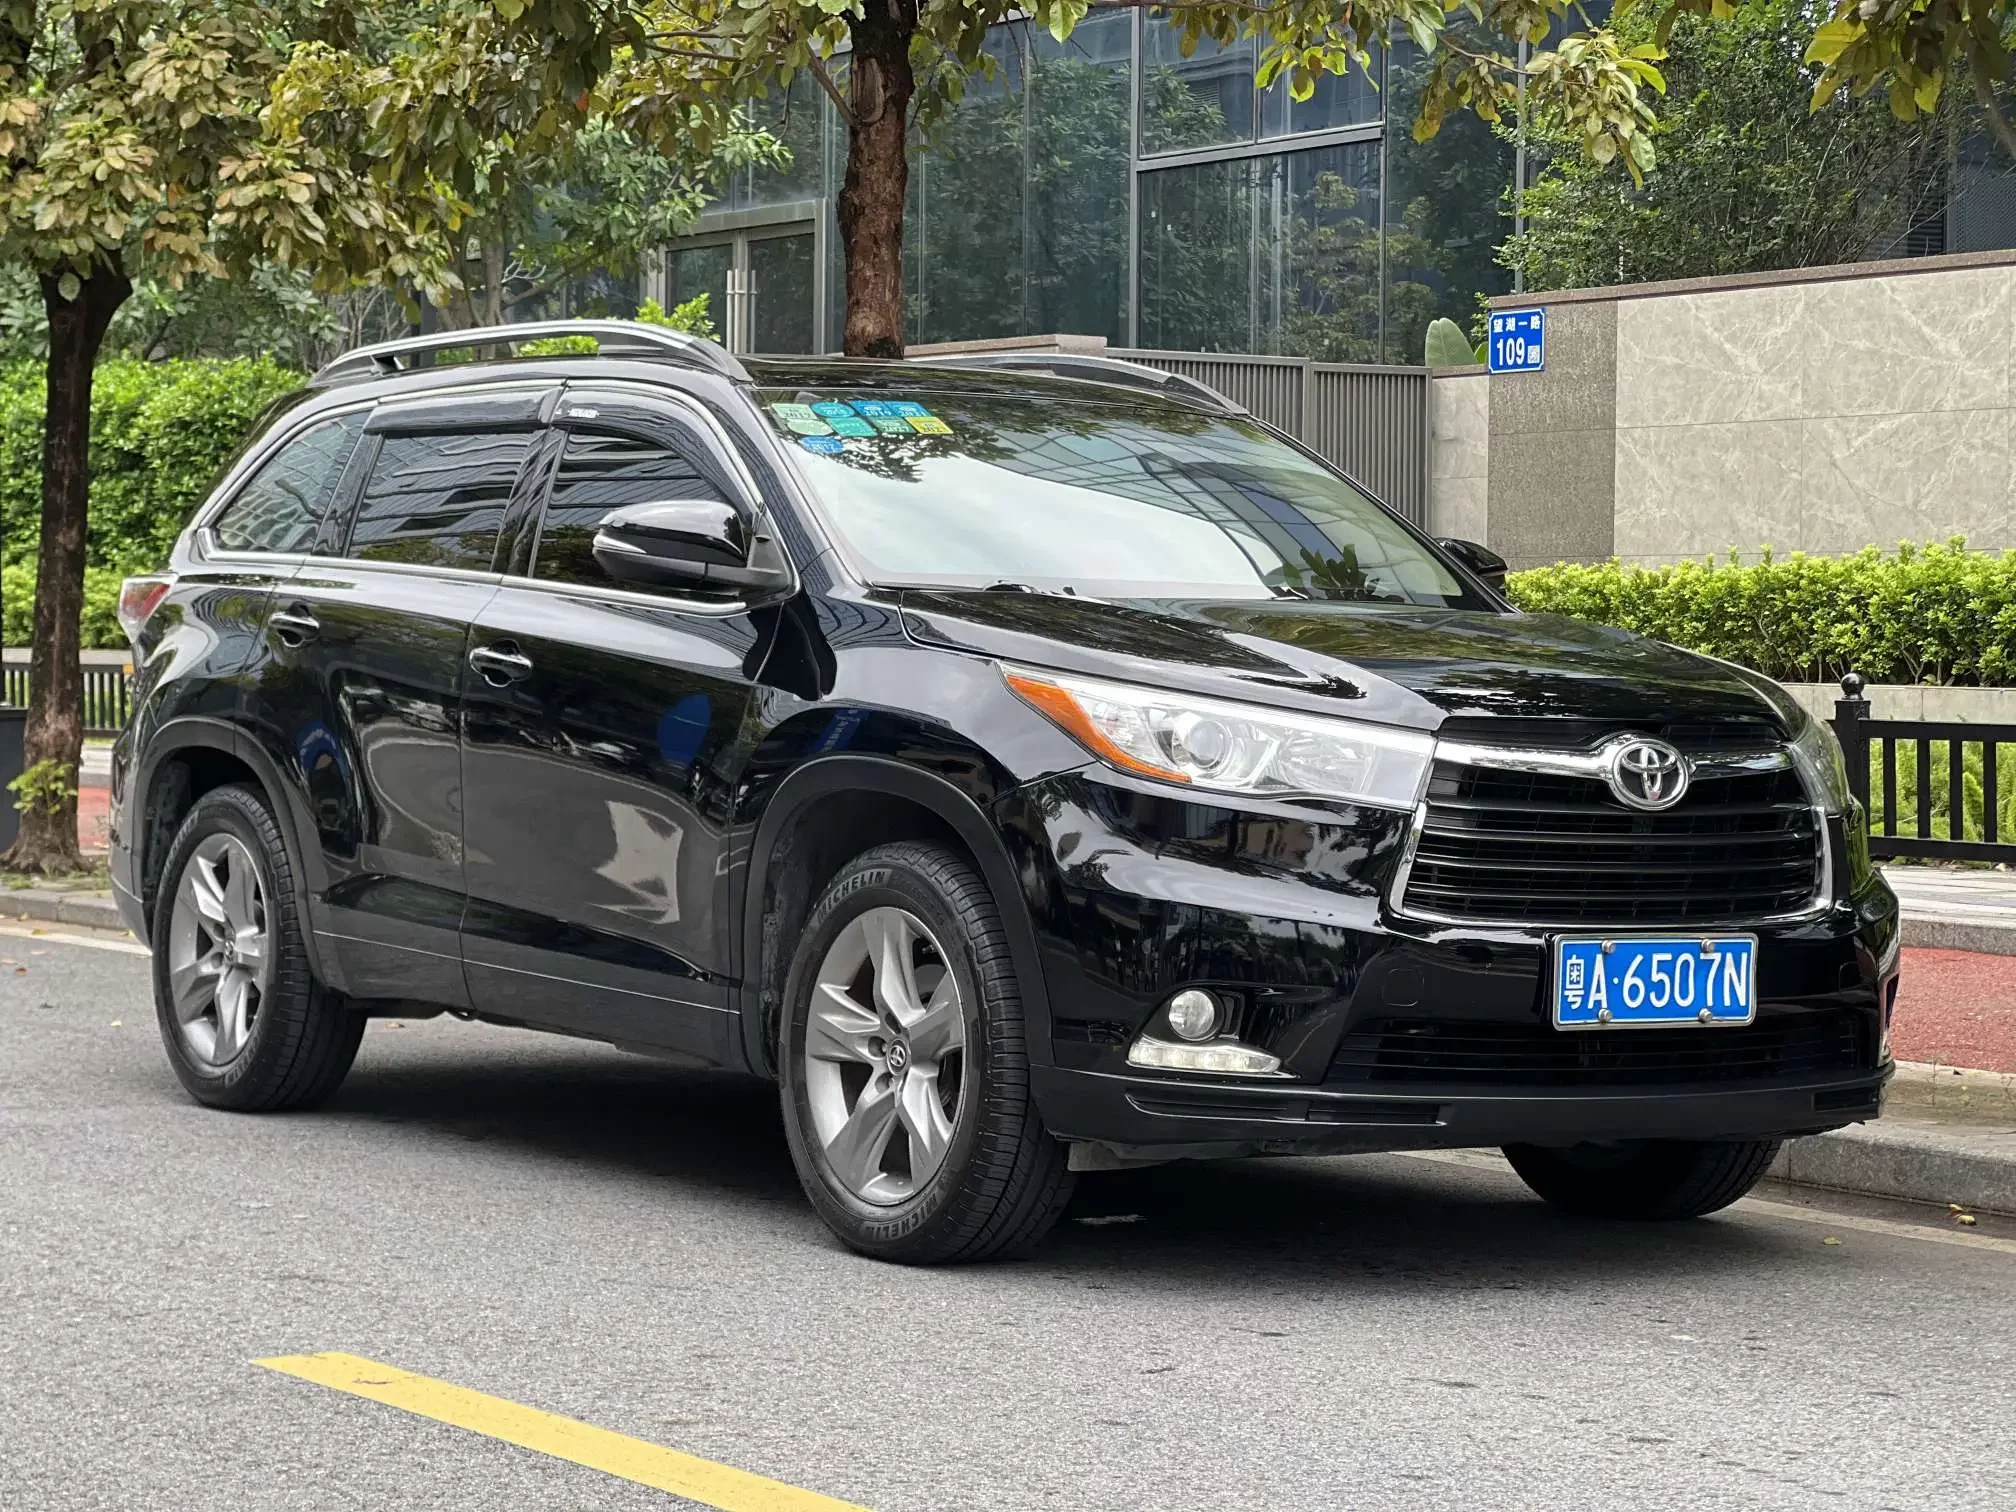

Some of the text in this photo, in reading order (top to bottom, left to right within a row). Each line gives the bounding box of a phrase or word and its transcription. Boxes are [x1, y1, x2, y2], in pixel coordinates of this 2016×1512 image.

[1493, 315, 1541, 333] 望湖一路
[1496, 337, 1525, 366] 109
[817, 871, 885, 919] MICHELIN
